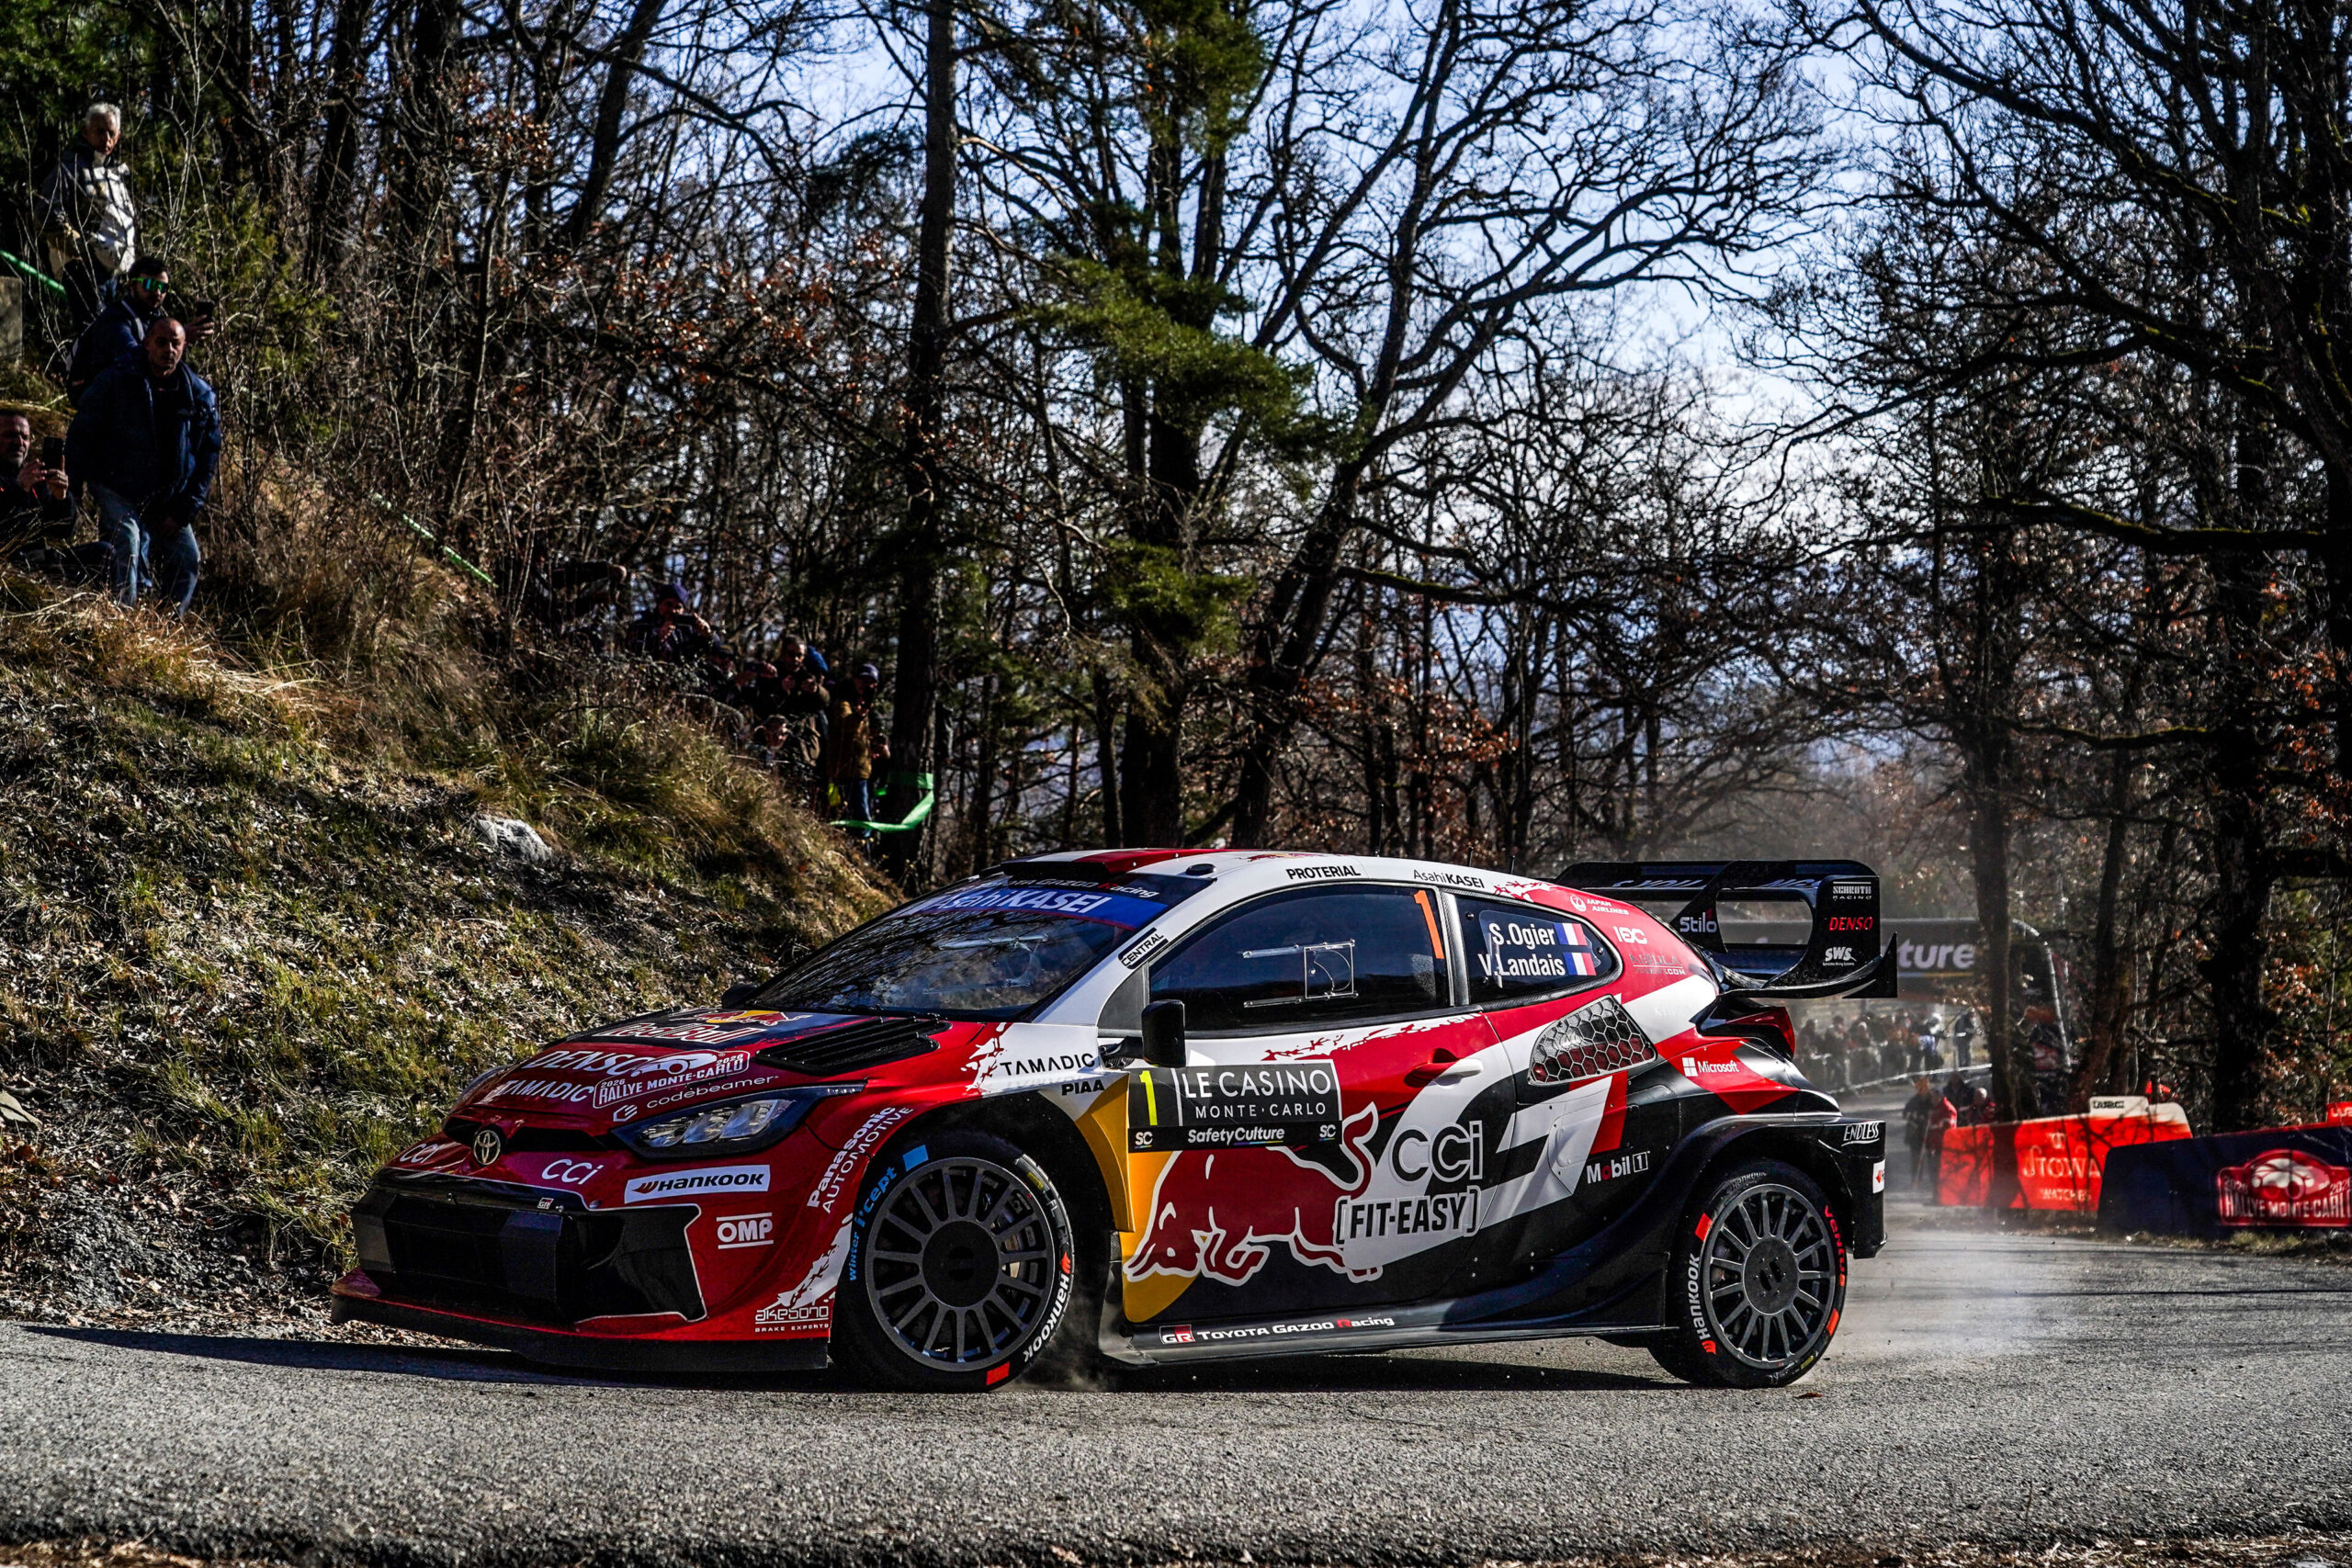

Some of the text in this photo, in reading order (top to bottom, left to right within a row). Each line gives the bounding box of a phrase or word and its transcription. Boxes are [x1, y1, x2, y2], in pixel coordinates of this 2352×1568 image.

[1286, 865, 1362, 880] PROTERIAL
[1413, 869, 1485, 889] AsahiKASEI
[1097, 882, 1159, 898] Racing
[1587, 899, 1612, 908] JAPAN
[1592, 906, 1630, 916] AIRLINES
[1414, 890, 1444, 960] 1
[1679, 911, 1717, 933] Stilo
[1828, 917, 1873, 931] DENSO
[1488, 922, 1555, 950] S.Ogier
[1121, 931, 1164, 967] CENTRAL
[1824, 946, 1853, 962] SWS
[1896, 939, 1974, 970] ture
[1478, 953, 1566, 976] V.Landais
[1000, 1053, 1095, 1076] TAMADIC
[1697, 1059, 1739, 1074] Microsoft
[598, 1057, 744, 1105] RALLYE MONTE-CARLO
[599, 1078, 626, 1089] 2026
[647, 1076, 775, 1109] codebeamer
[1061, 1079, 1106, 1096] PIAA
[1139, 1069, 1332, 1126] 1 LE CASINO
[1195, 1102, 1326, 1119] MONTE CARLO
[1136, 1123, 1337, 1146] SC SafetyCulture SC
[1842, 1122, 1880, 1142] ENDLESS
[807, 1107, 896, 1208] Panasonic
[822, 1107, 914, 1213] AUTOMOTIVE
[1587, 1156, 1632, 1184] Mobil
[717, 1218, 774, 1243] OMP
[791, 1323, 830, 1331] EXPERTS
[1161, 1316, 1396, 1344] GR TOYOTA GAZOO Racing
